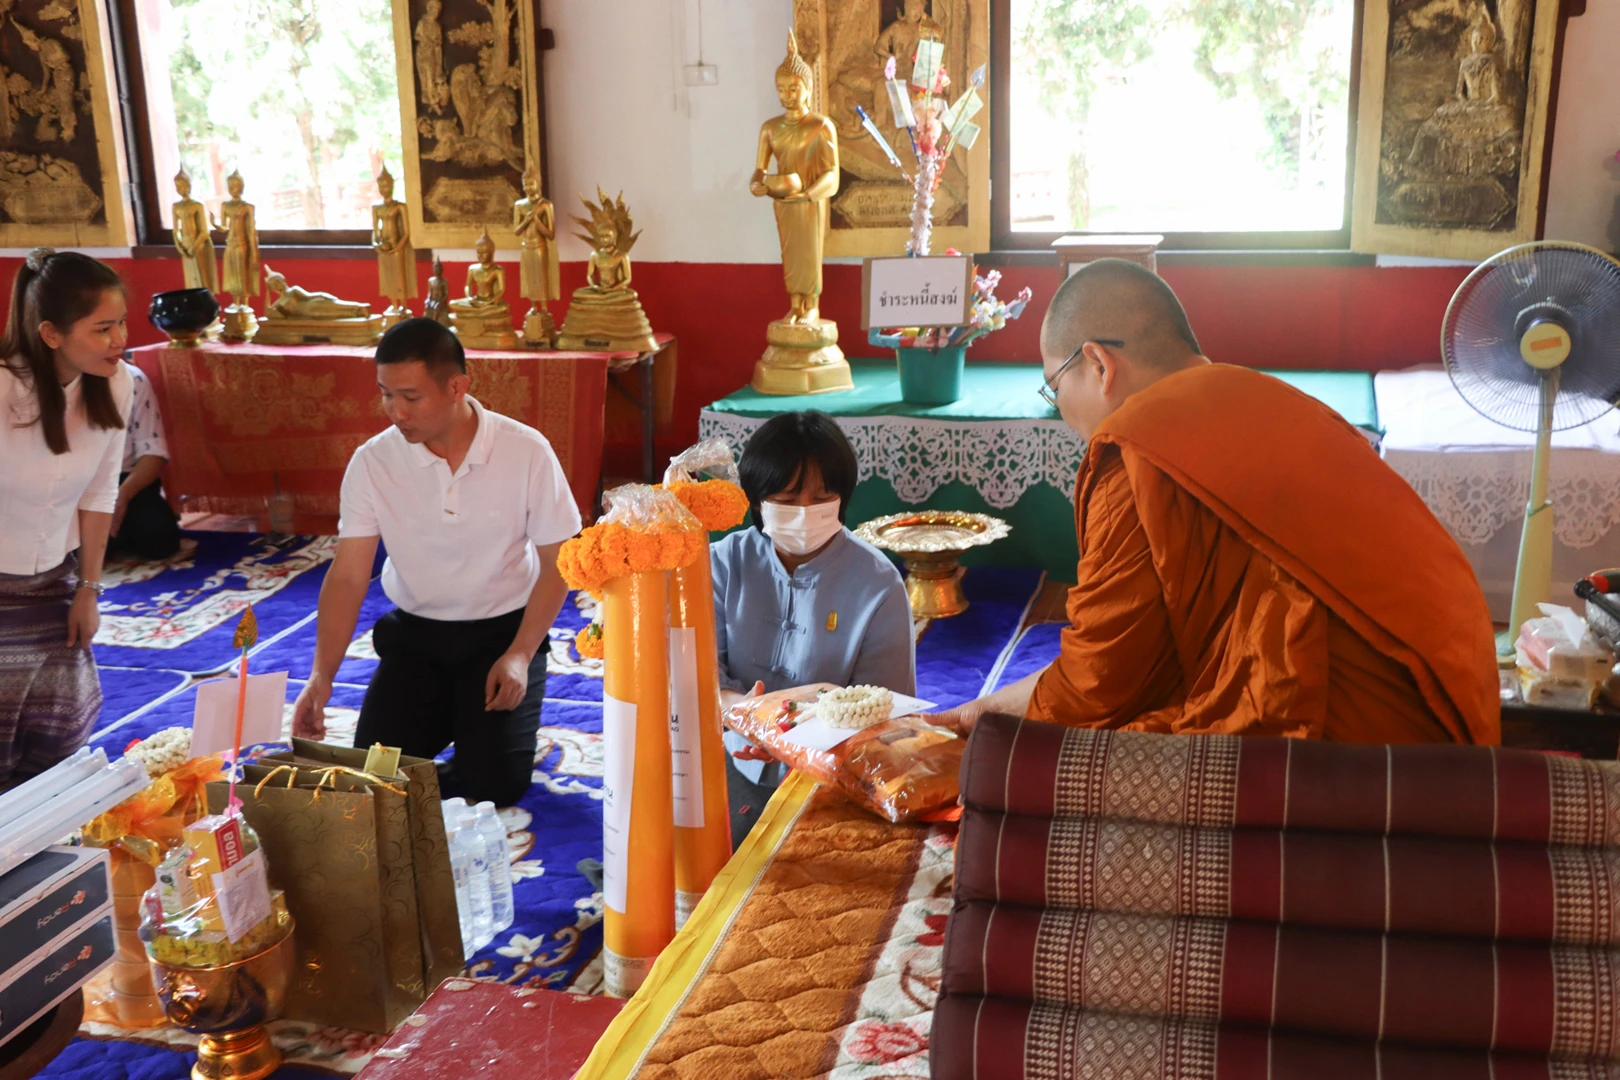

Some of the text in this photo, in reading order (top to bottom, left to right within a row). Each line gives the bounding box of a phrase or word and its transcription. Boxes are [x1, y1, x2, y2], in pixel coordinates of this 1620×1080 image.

[879, 282, 958, 308] ชำระหนี้สงฆ์
